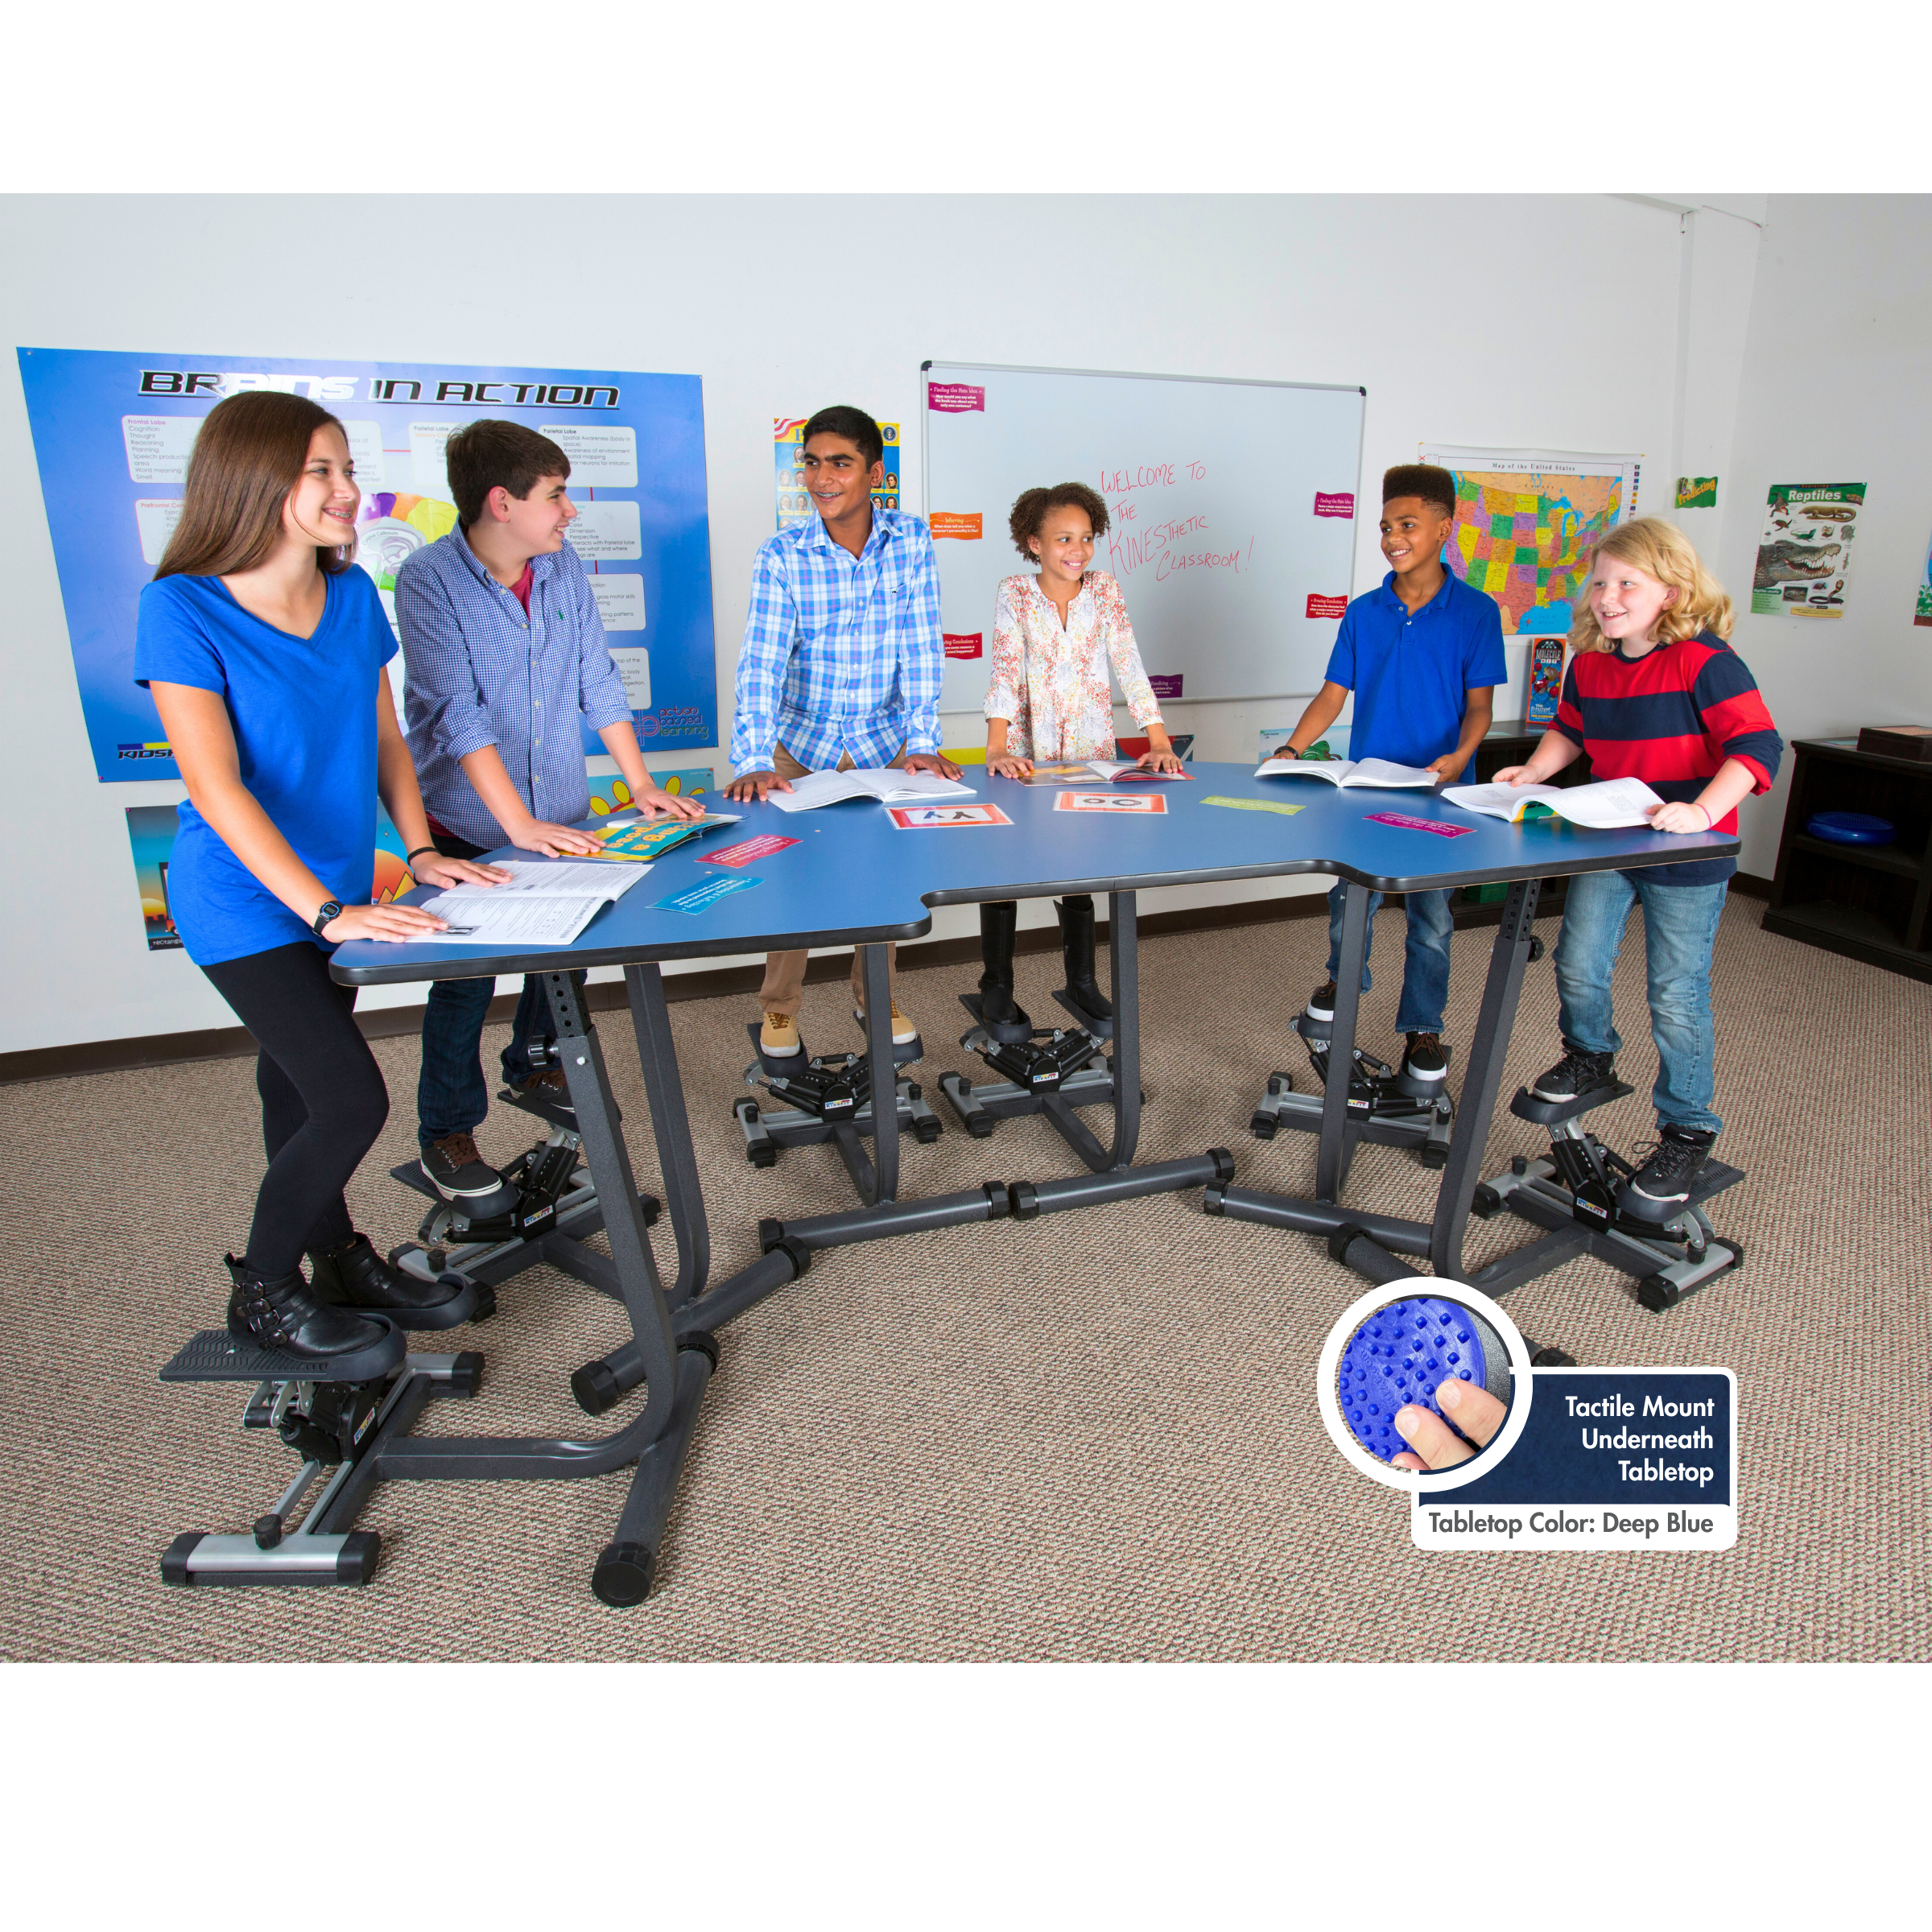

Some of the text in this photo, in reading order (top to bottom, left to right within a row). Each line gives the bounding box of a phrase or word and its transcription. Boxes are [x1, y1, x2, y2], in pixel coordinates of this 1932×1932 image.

[139, 369, 620, 407] BRAINS IN ACTION
[1101, 460, 1206, 494] WELCOME TO
[1678, 479, 1716, 506] Predicting
[1788, 489, 1841, 503] Reptiles
[1110, 499, 1137, 523] THE
[362, 530, 376, 546] Corpus
[1108, 515, 1209, 580] KINESTHETIC
[1536, 649, 1562, 660] MOLECULE
[658, 705, 698, 716] action
[1531, 706, 1551, 715] ELEMENTS
[659, 724, 708, 739] learning
[1578, 1200, 1603, 1215] KIDSFIT
[526, 1210, 550, 1224] KIDSFIT
